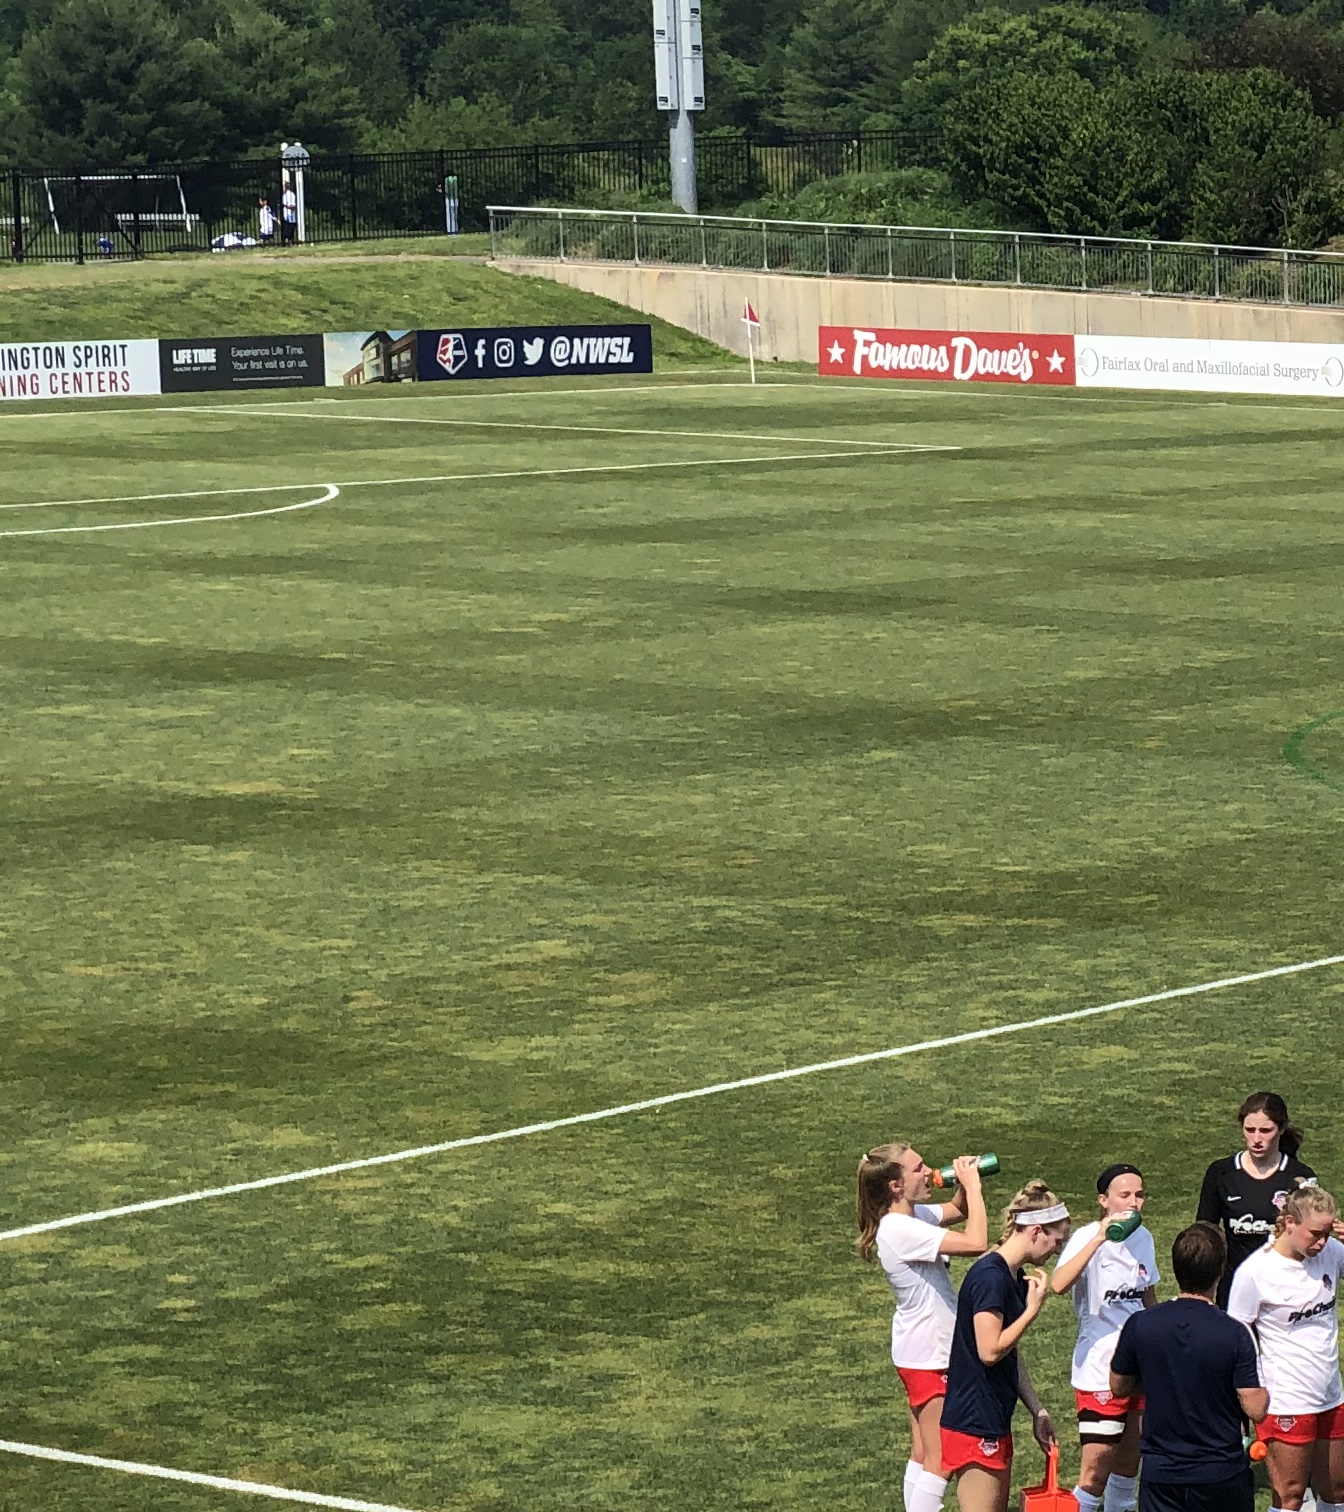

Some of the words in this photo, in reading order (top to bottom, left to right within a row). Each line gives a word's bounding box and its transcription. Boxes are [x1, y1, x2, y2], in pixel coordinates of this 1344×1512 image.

[1, 345, 65, 371] INGTON
[73, 344, 128, 368] SPIRIT
[231, 347, 270, 358] Experience
[271, 346, 283, 356] Life
[550, 336, 634, 367] @NWSL
[853, 329, 949, 374] Famous
[951, 336, 1033, 382] Dave's
[1102, 356, 1141, 372] Fairfax
[1144, 357, 1169, 373] Oral
[1173, 359, 1194, 374] and
[1197, 360, 1270, 377] Maxillofacial
[1273, 363, 1319, 381] Surgery
[50, 371, 130, 395] CENTERS
